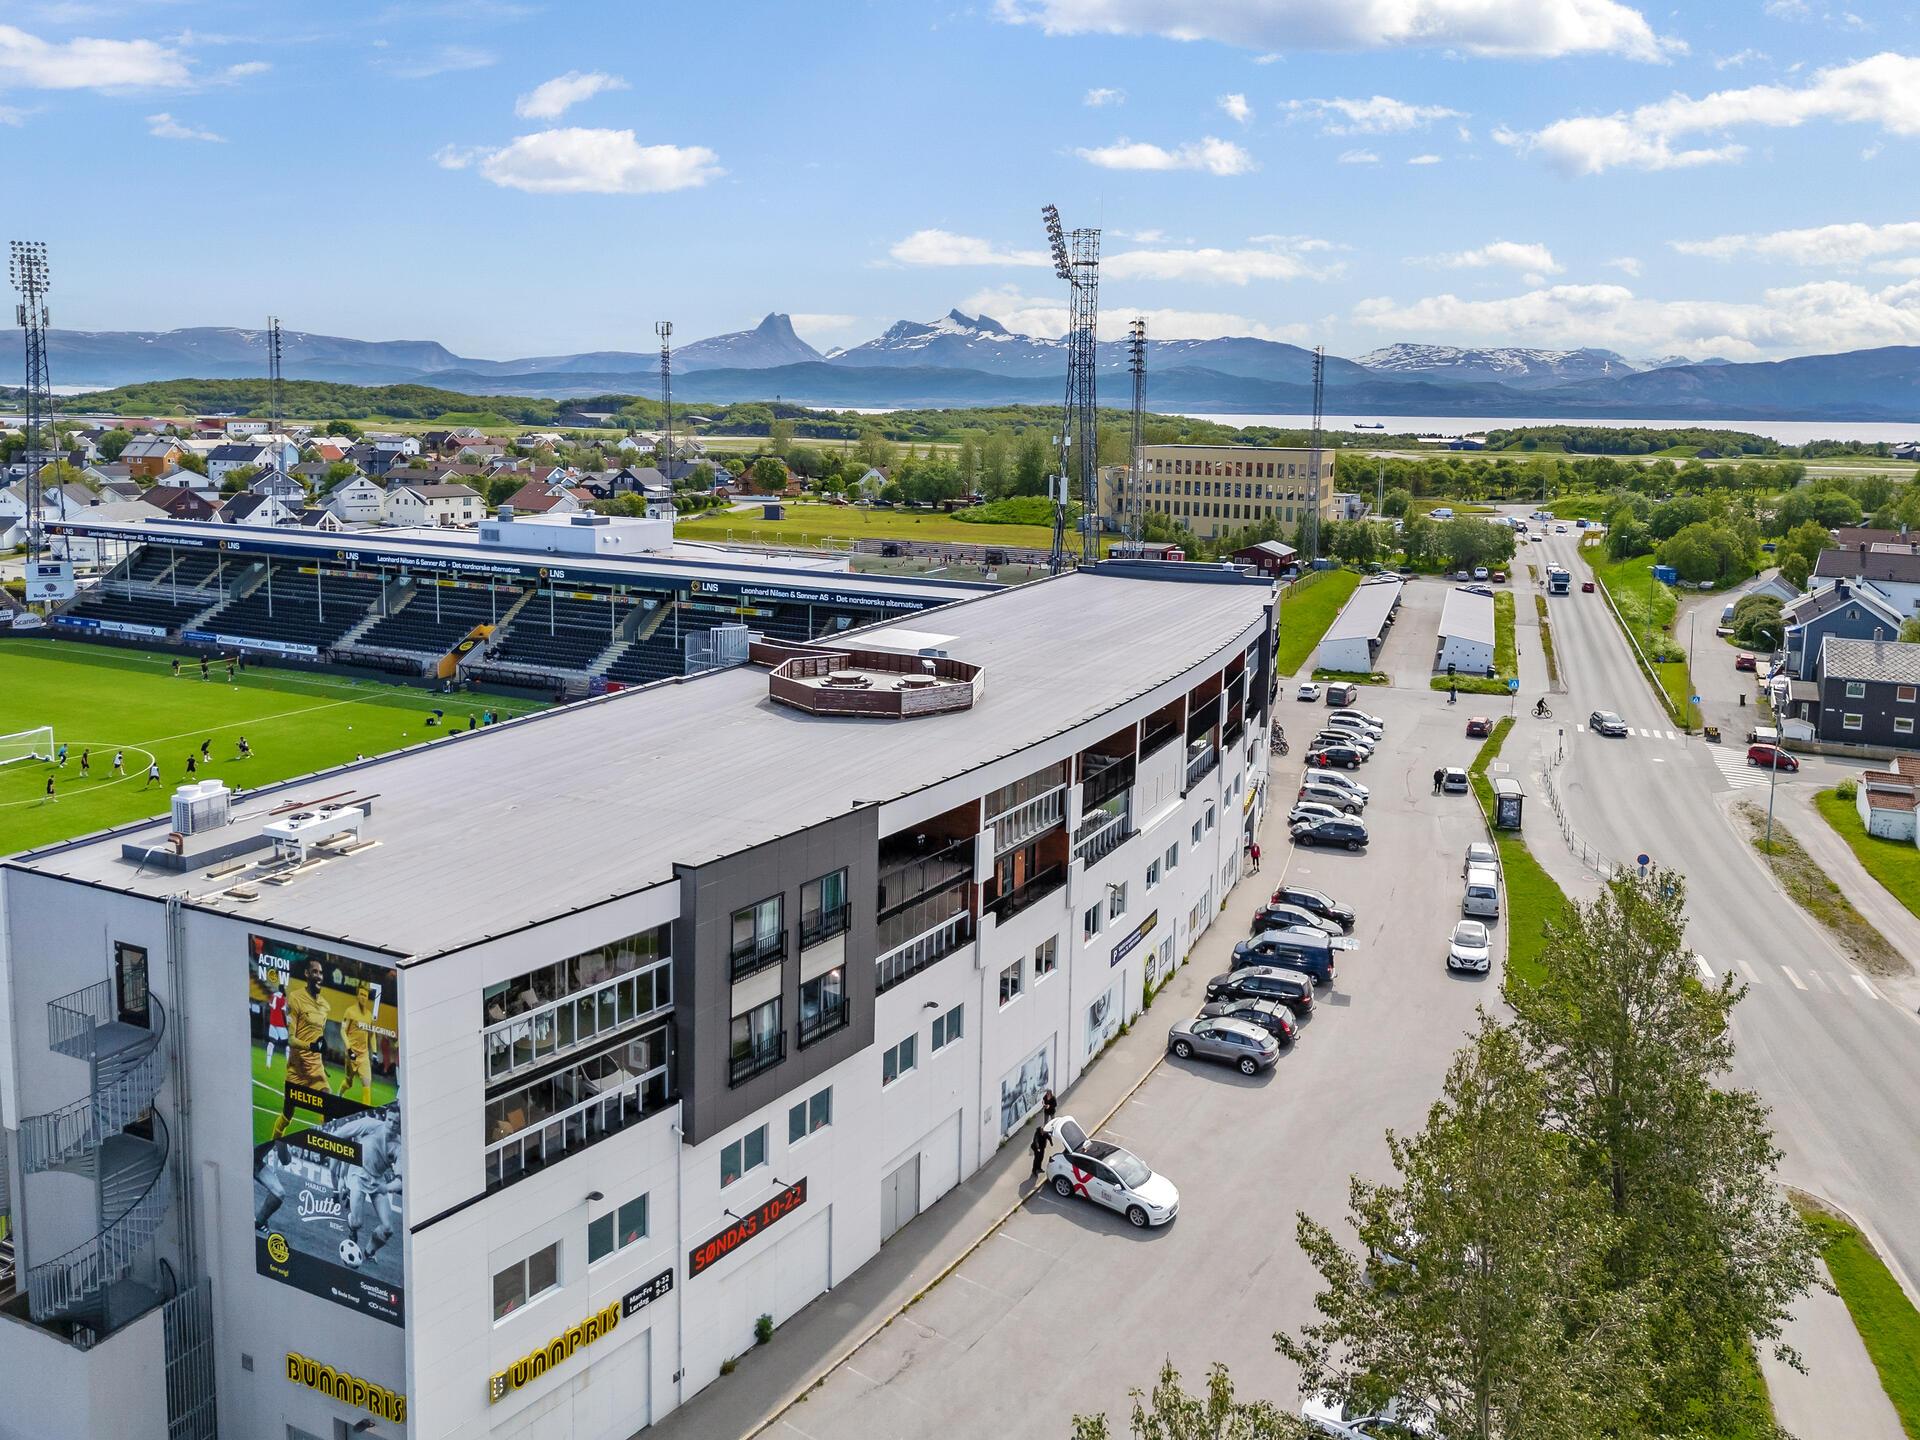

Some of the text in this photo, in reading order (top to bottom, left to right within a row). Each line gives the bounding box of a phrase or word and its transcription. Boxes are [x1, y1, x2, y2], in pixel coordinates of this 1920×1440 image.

[227, 542, 240, 550] LNS
[346, 552, 359, 560] LNS
[452, 561, 462, 569] Det
[549, 569, 565, 578] LNS
[702, 582, 719, 592] LNS
[741, 586, 769, 596] Leonhard
[769, 589, 789, 598] Nilsen
[790, 590, 796, 598] &
[819, 593, 829, 601] AS
[836, 595, 848, 603] Det
[848, 596, 885, 606] nordnorske
[885, 599, 924, 609] alternativet
[259, 953, 290, 971] ACTION
[369, 982, 382, 1021] 7
[359, 1022, 397, 1039] PELLEGRINO
[290, 1088, 324, 1108] HELTER
[307, 1133, 355, 1158] LEGENDER
[304, 1181, 327, 1193] HARALD
[298, 1189, 342, 1216] Dutte
[695, 1186, 801, 1270] SØNDAG 10-22
[656, 1275, 669, 1288] 8-22
[656, 1283, 669, 1297] 9-21
[489, 1301, 622, 1404] BUNNPRIS
[286, 1352, 406, 1424] BUNNPRIS
